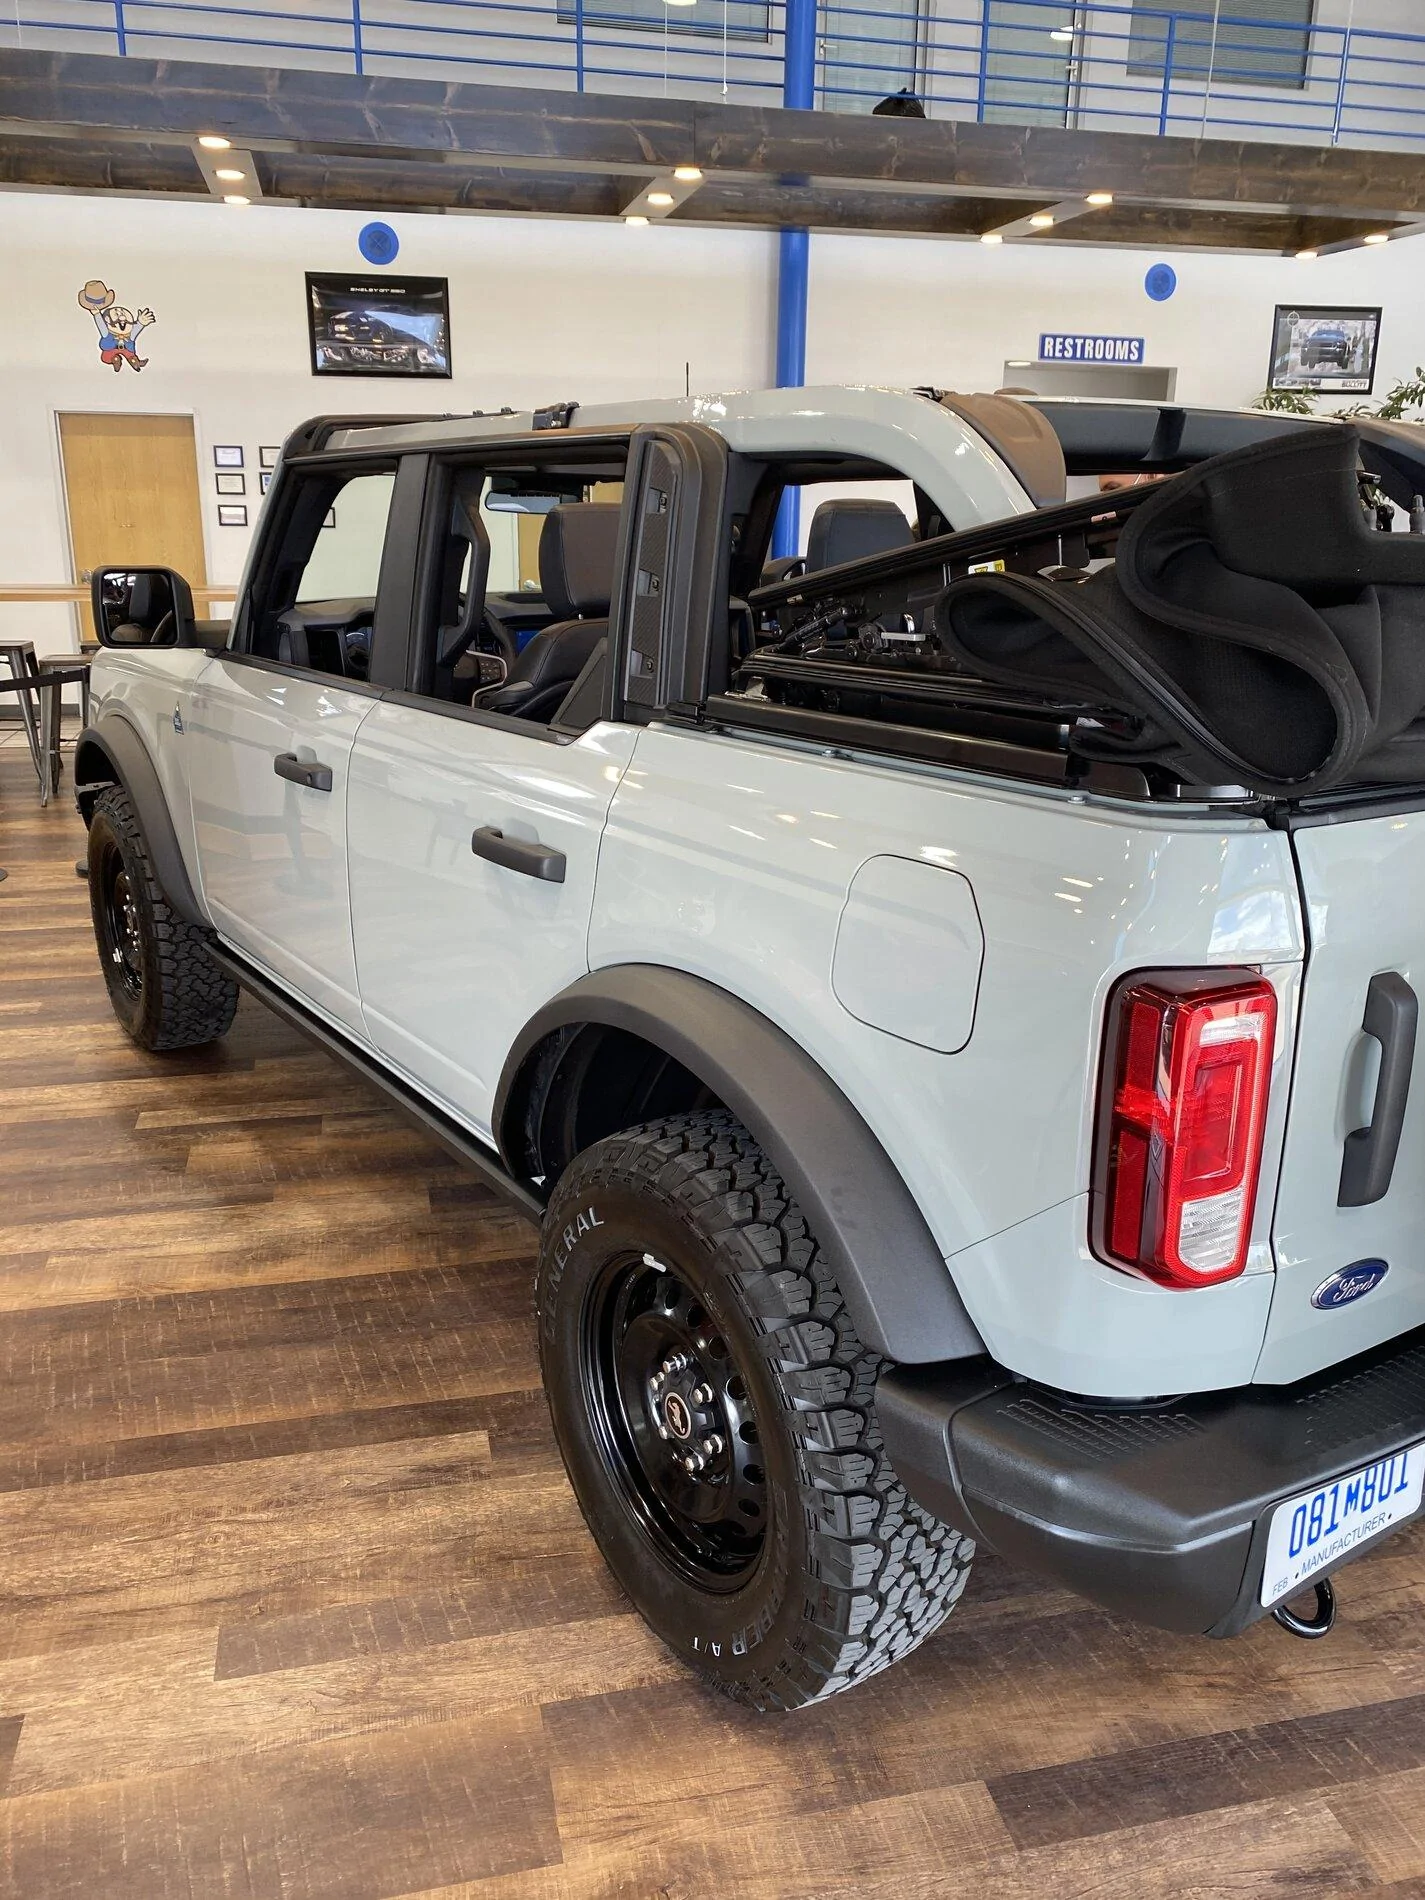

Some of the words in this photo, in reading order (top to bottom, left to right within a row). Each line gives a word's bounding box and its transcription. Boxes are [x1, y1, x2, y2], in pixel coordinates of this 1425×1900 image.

[1043, 336, 1140, 361] RESTROOMS
[1332, 1273, 1376, 1303] Ford
[1271, 1577, 1289, 1596] FEB
[1300, 1511, 1387, 1575] MANUFACTURER
